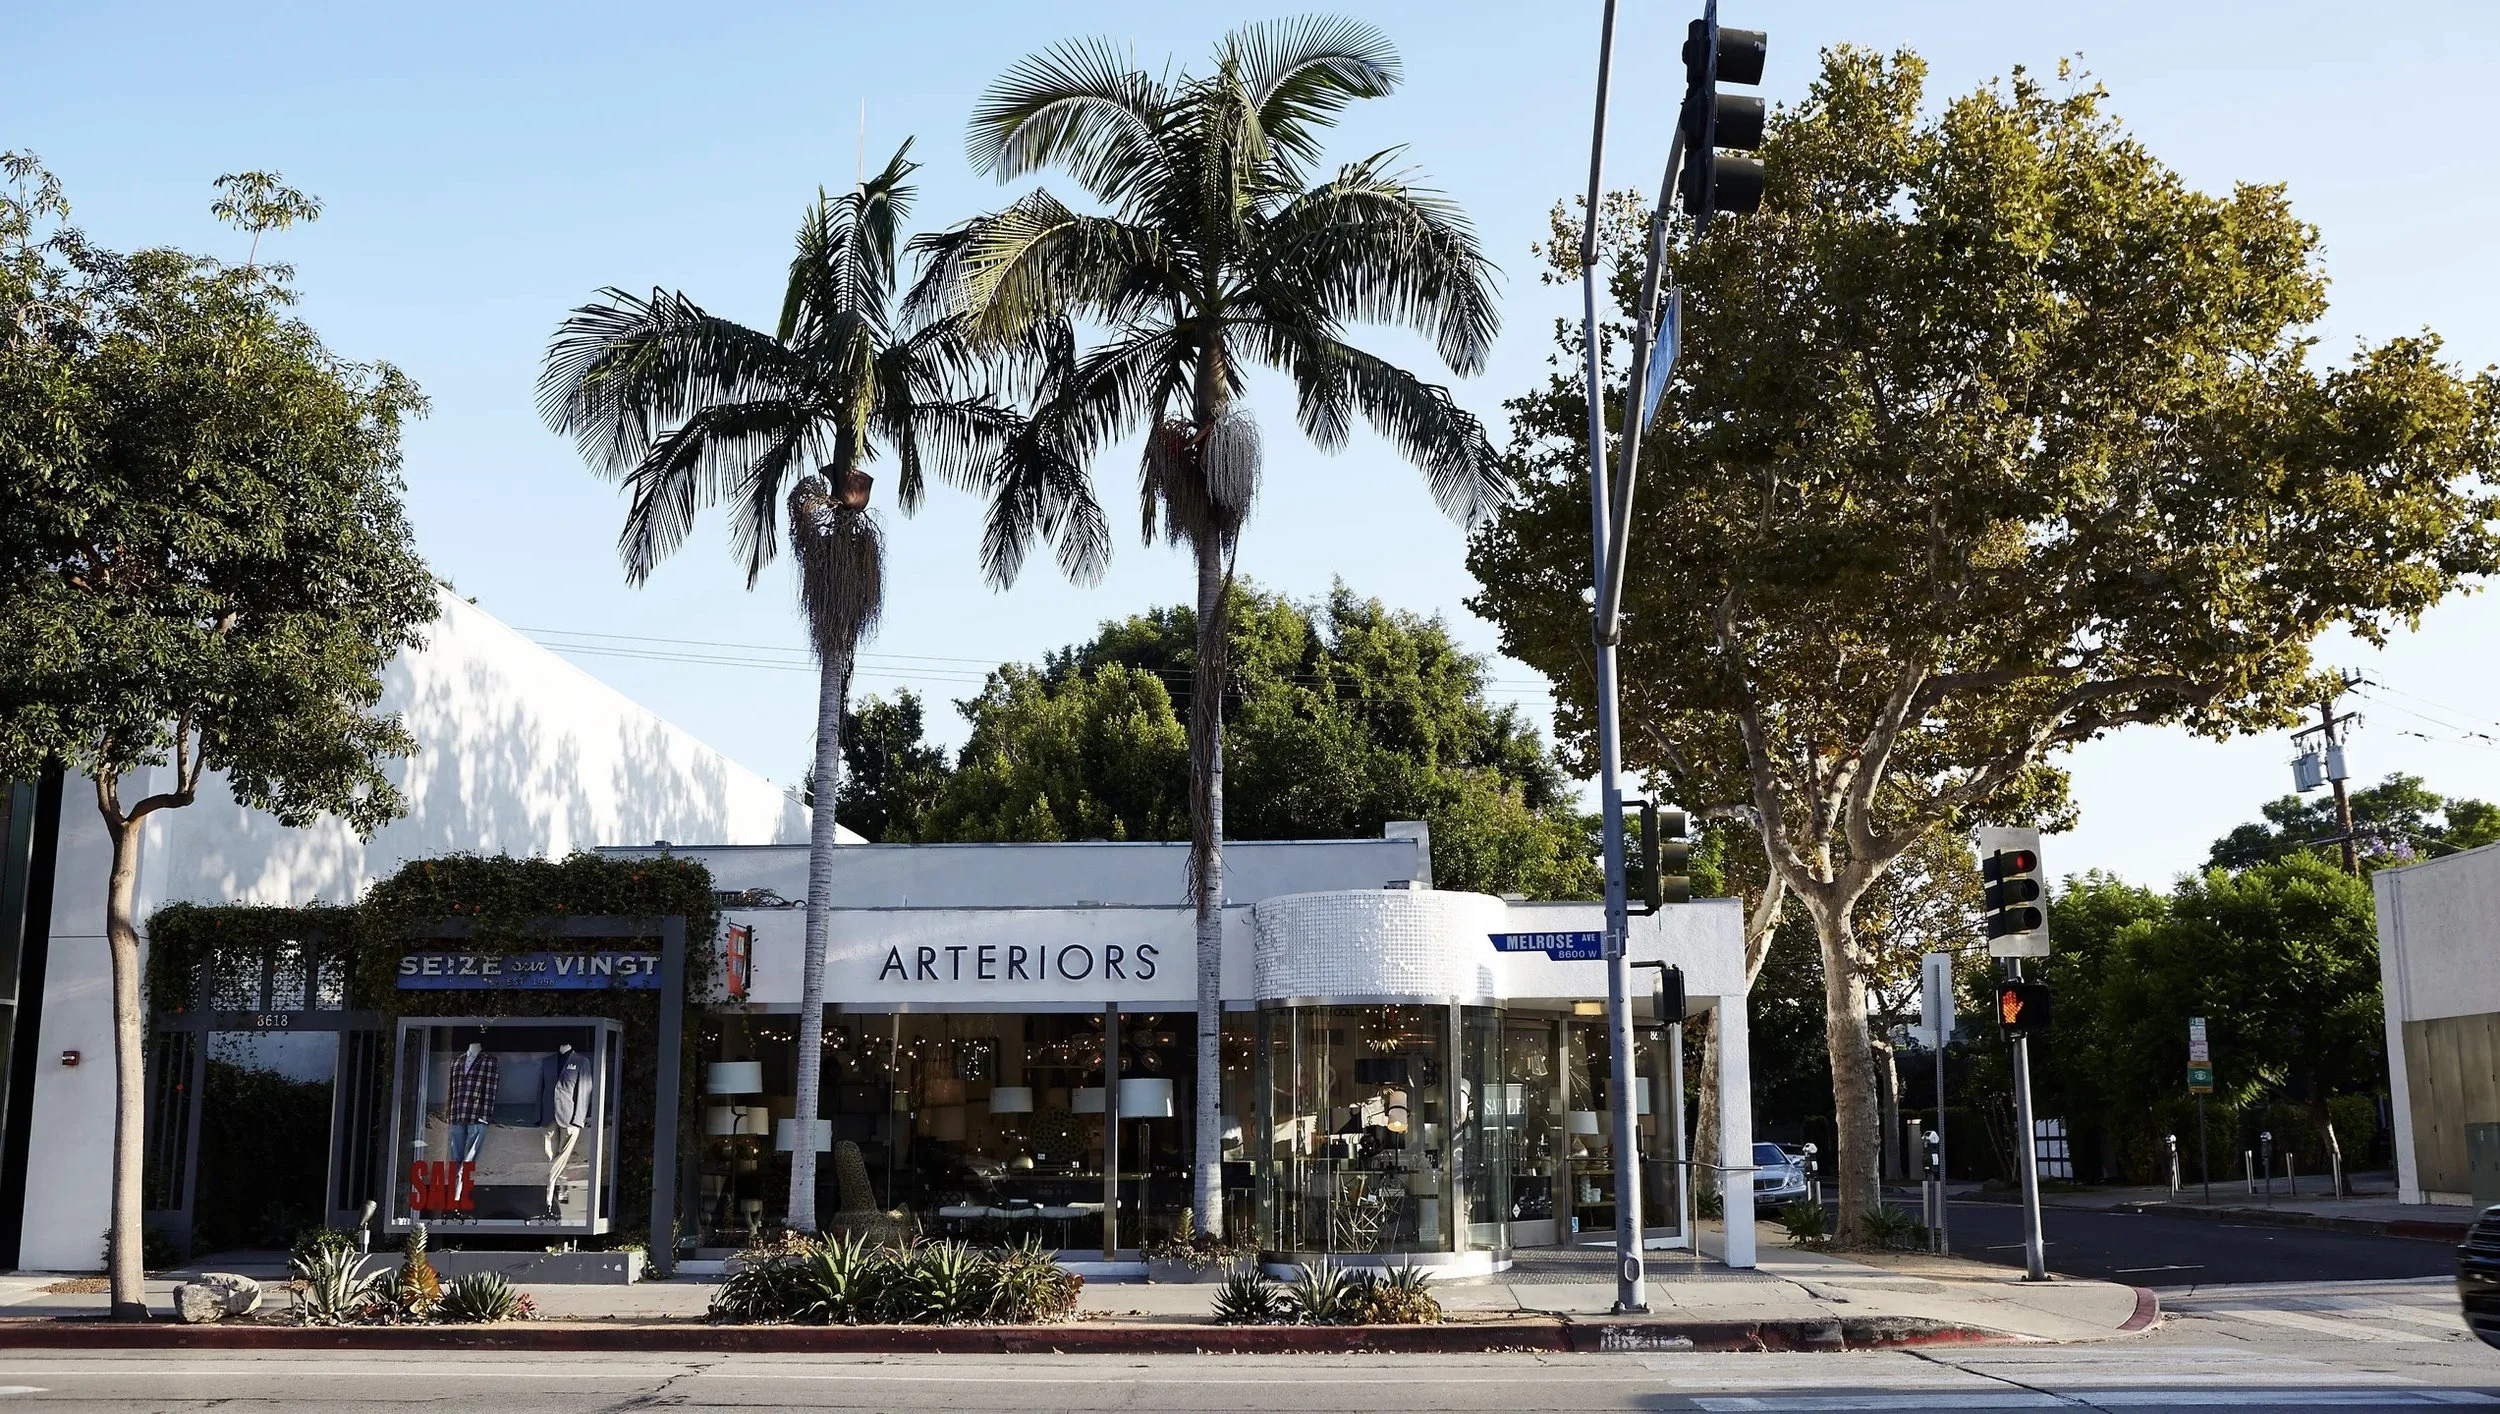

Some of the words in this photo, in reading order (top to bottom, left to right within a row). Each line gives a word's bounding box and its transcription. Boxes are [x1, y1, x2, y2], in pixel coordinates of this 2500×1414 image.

[1506, 934, 1574, 950] MELROSE
[1581, 933, 1596, 942] AVE
[878, 944, 1159, 981] ARTERIORS
[1558, 949, 1585, 959] 8600
[1588, 949, 1598, 958] W
[399, 956, 502, 976] SEIZE
[553, 955, 660, 976] VINGT
[257, 1014, 288, 1027] 8618
[408, 1160, 476, 1211] SALE
